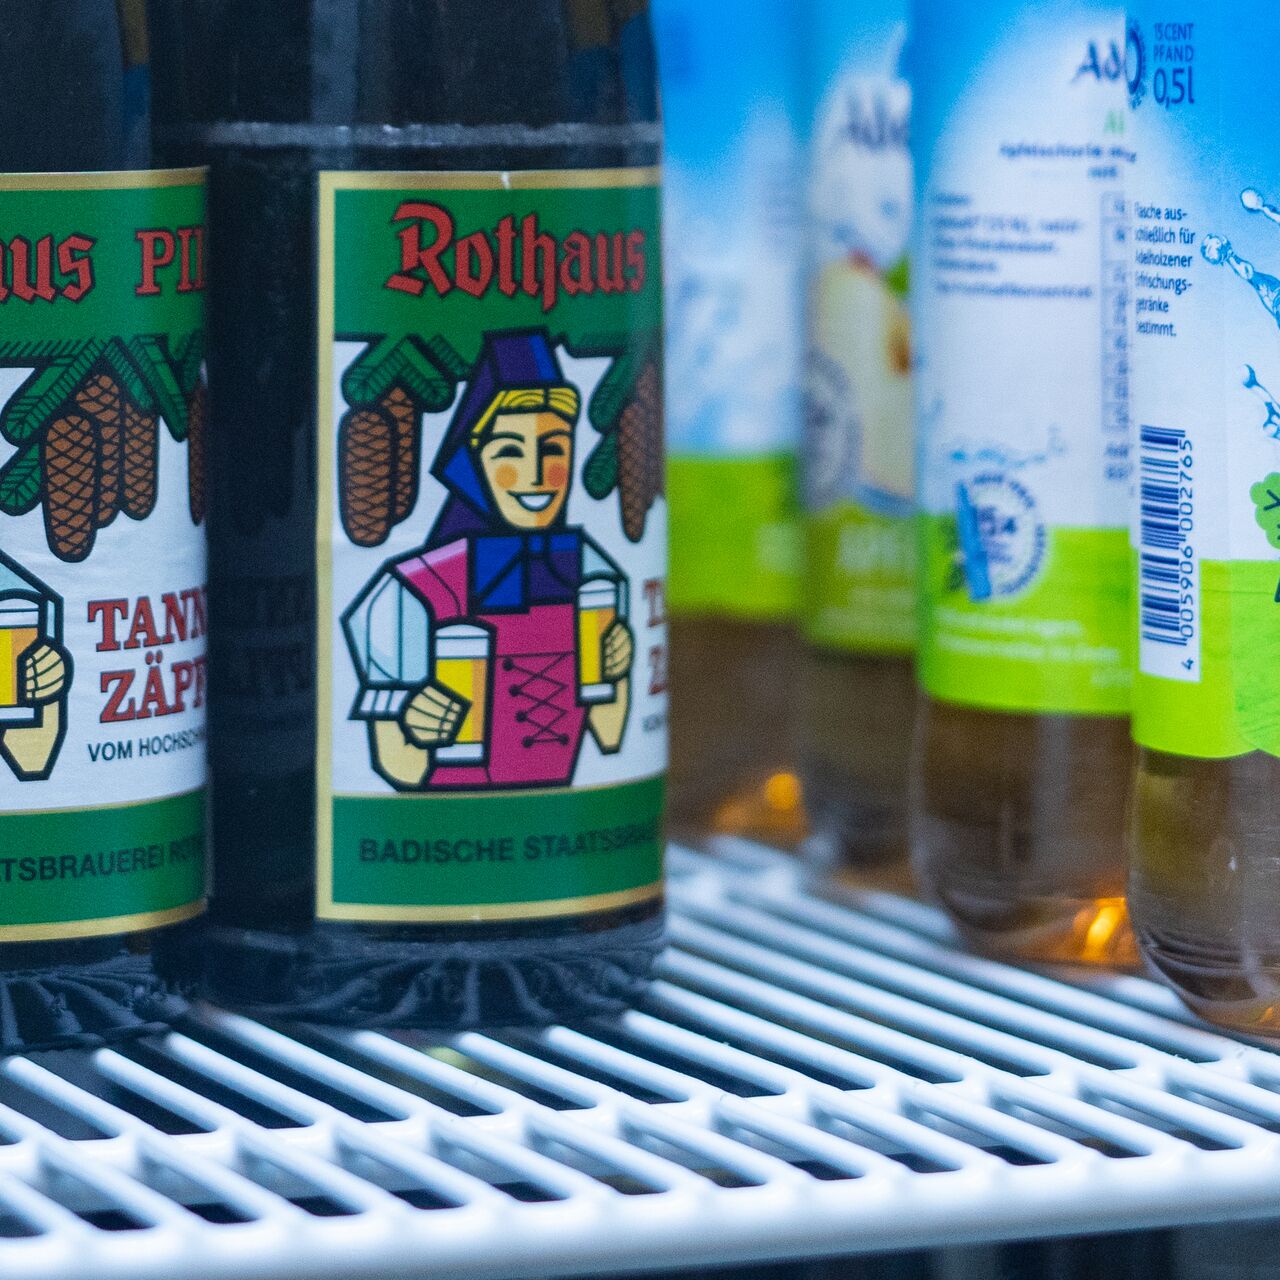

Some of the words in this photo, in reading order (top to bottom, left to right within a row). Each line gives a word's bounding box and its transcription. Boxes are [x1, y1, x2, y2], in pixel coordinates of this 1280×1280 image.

[1164, 23, 1194, 41] CENT
[1153, 45, 1194, 62] PFAND
[1164, 206, 1189, 221] aus-
[1179, 227, 1196, 244] für
[383, 198, 647, 313] Rothaus
[88, 739, 134, 763] VOM
[359, 837, 515, 864] BADISCHE
